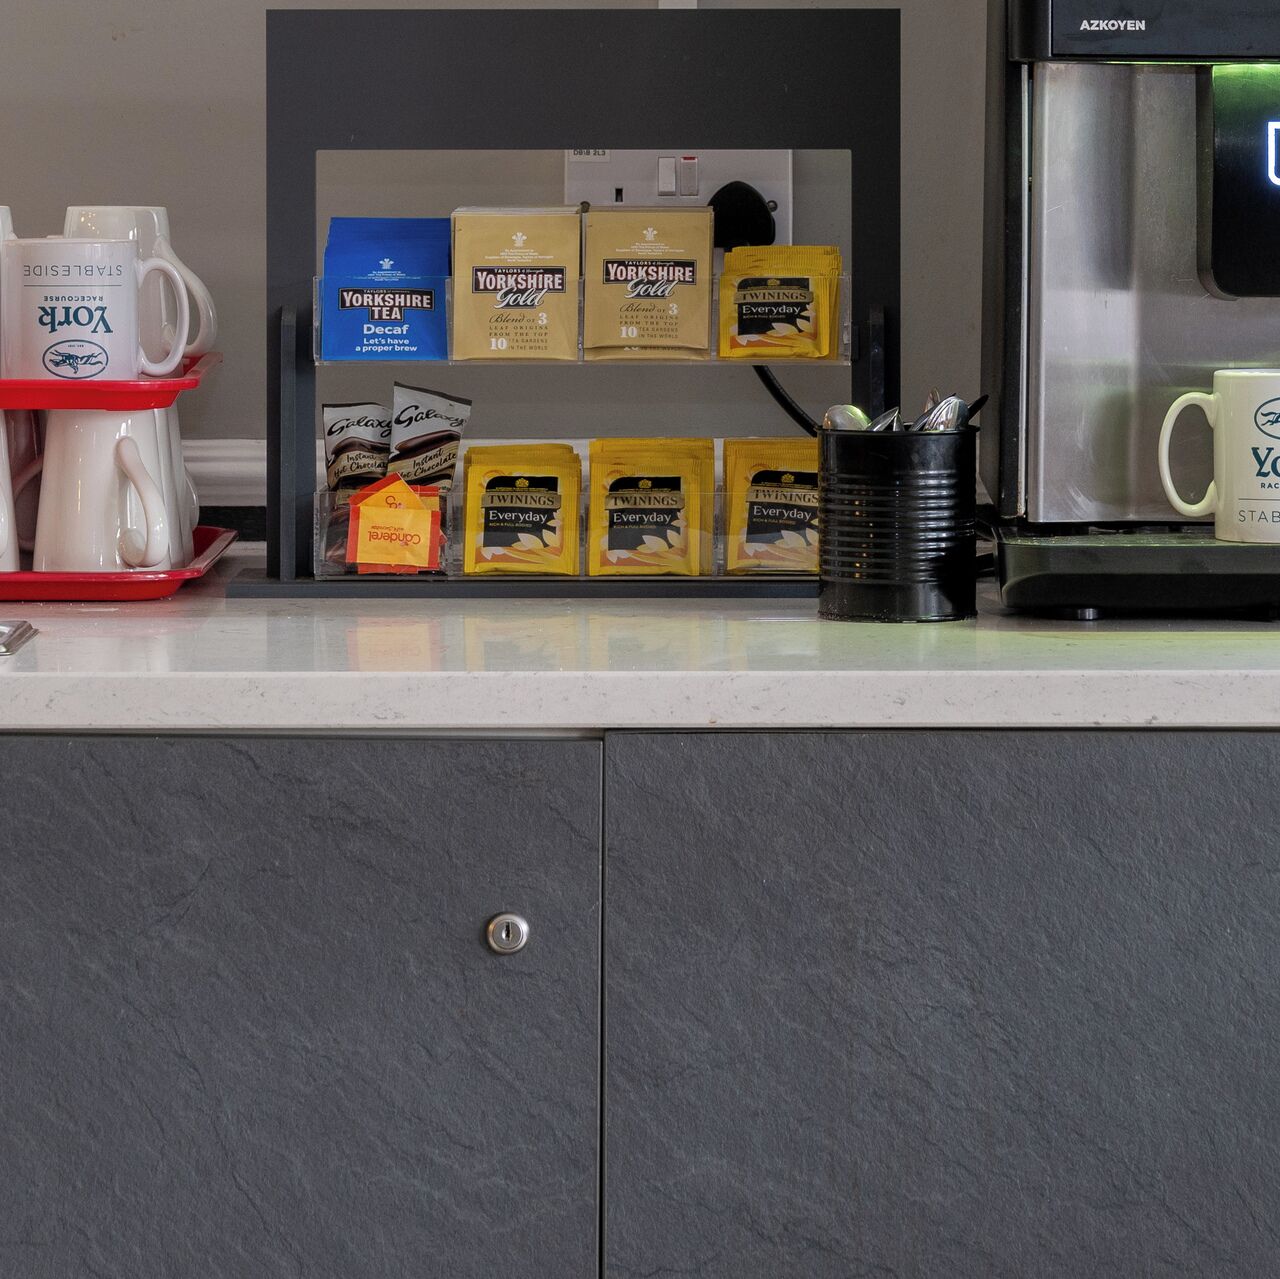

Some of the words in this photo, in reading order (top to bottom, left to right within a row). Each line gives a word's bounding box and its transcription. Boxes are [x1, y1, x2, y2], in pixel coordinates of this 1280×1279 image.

[1080, 20, 1146, 31] AZKOYEN
[23, 265, 122, 277] STABLESIDE
[607, 263, 693, 281] YORKSHIRE
[477, 271, 562, 290] YORKSHIRE
[624, 279, 679, 299] Gold
[742, 291, 807, 300] TWININGS
[342, 291, 431, 308] YORKSHIRE
[494, 287, 548, 309] Gold
[372, 307, 401, 319] TEA
[620, 302, 656, 313] Blend
[668, 303, 678, 315] 3
[742, 305, 801, 315] Everyday
[37, 306, 113, 334] York
[489, 313, 525, 323] Blend
[538, 312, 547, 325] 3
[363, 324, 410, 334] Decaf
[620, 326, 638, 338] 10
[490, 338, 508, 350] 10
[394, 405, 466, 428] Galaxy
[413, 448, 443, 469] Instant
[414, 453, 457, 478] Chocolate
[487, 494, 555, 506] TWININGS
[613, 496, 678, 507] TWININGS
[754, 489, 818, 503] TWININGS
[489, 510, 548, 524] Everyday
[613, 512, 671, 525] Everyday
[753, 505, 811, 521] Everyday
[368, 530, 421, 545] Canderel
